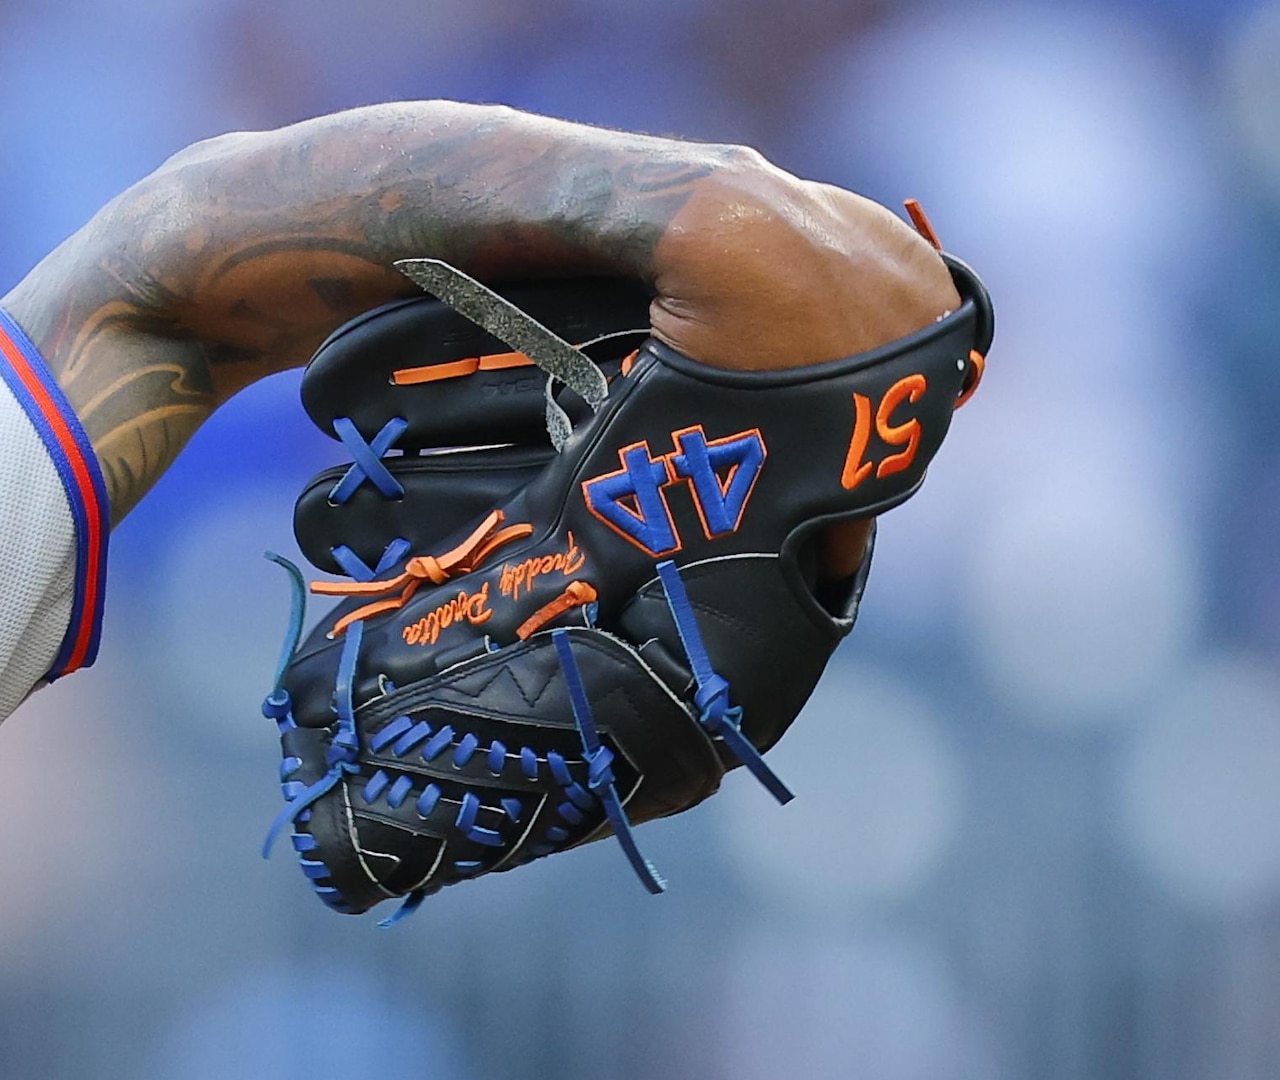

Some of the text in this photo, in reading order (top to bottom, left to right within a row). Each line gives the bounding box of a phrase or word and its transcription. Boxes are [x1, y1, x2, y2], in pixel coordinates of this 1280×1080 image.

[581, 423, 768, 558] 44
[840, 372, 927, 491] 51
[402, 530, 586, 646] Freddy Peralta
